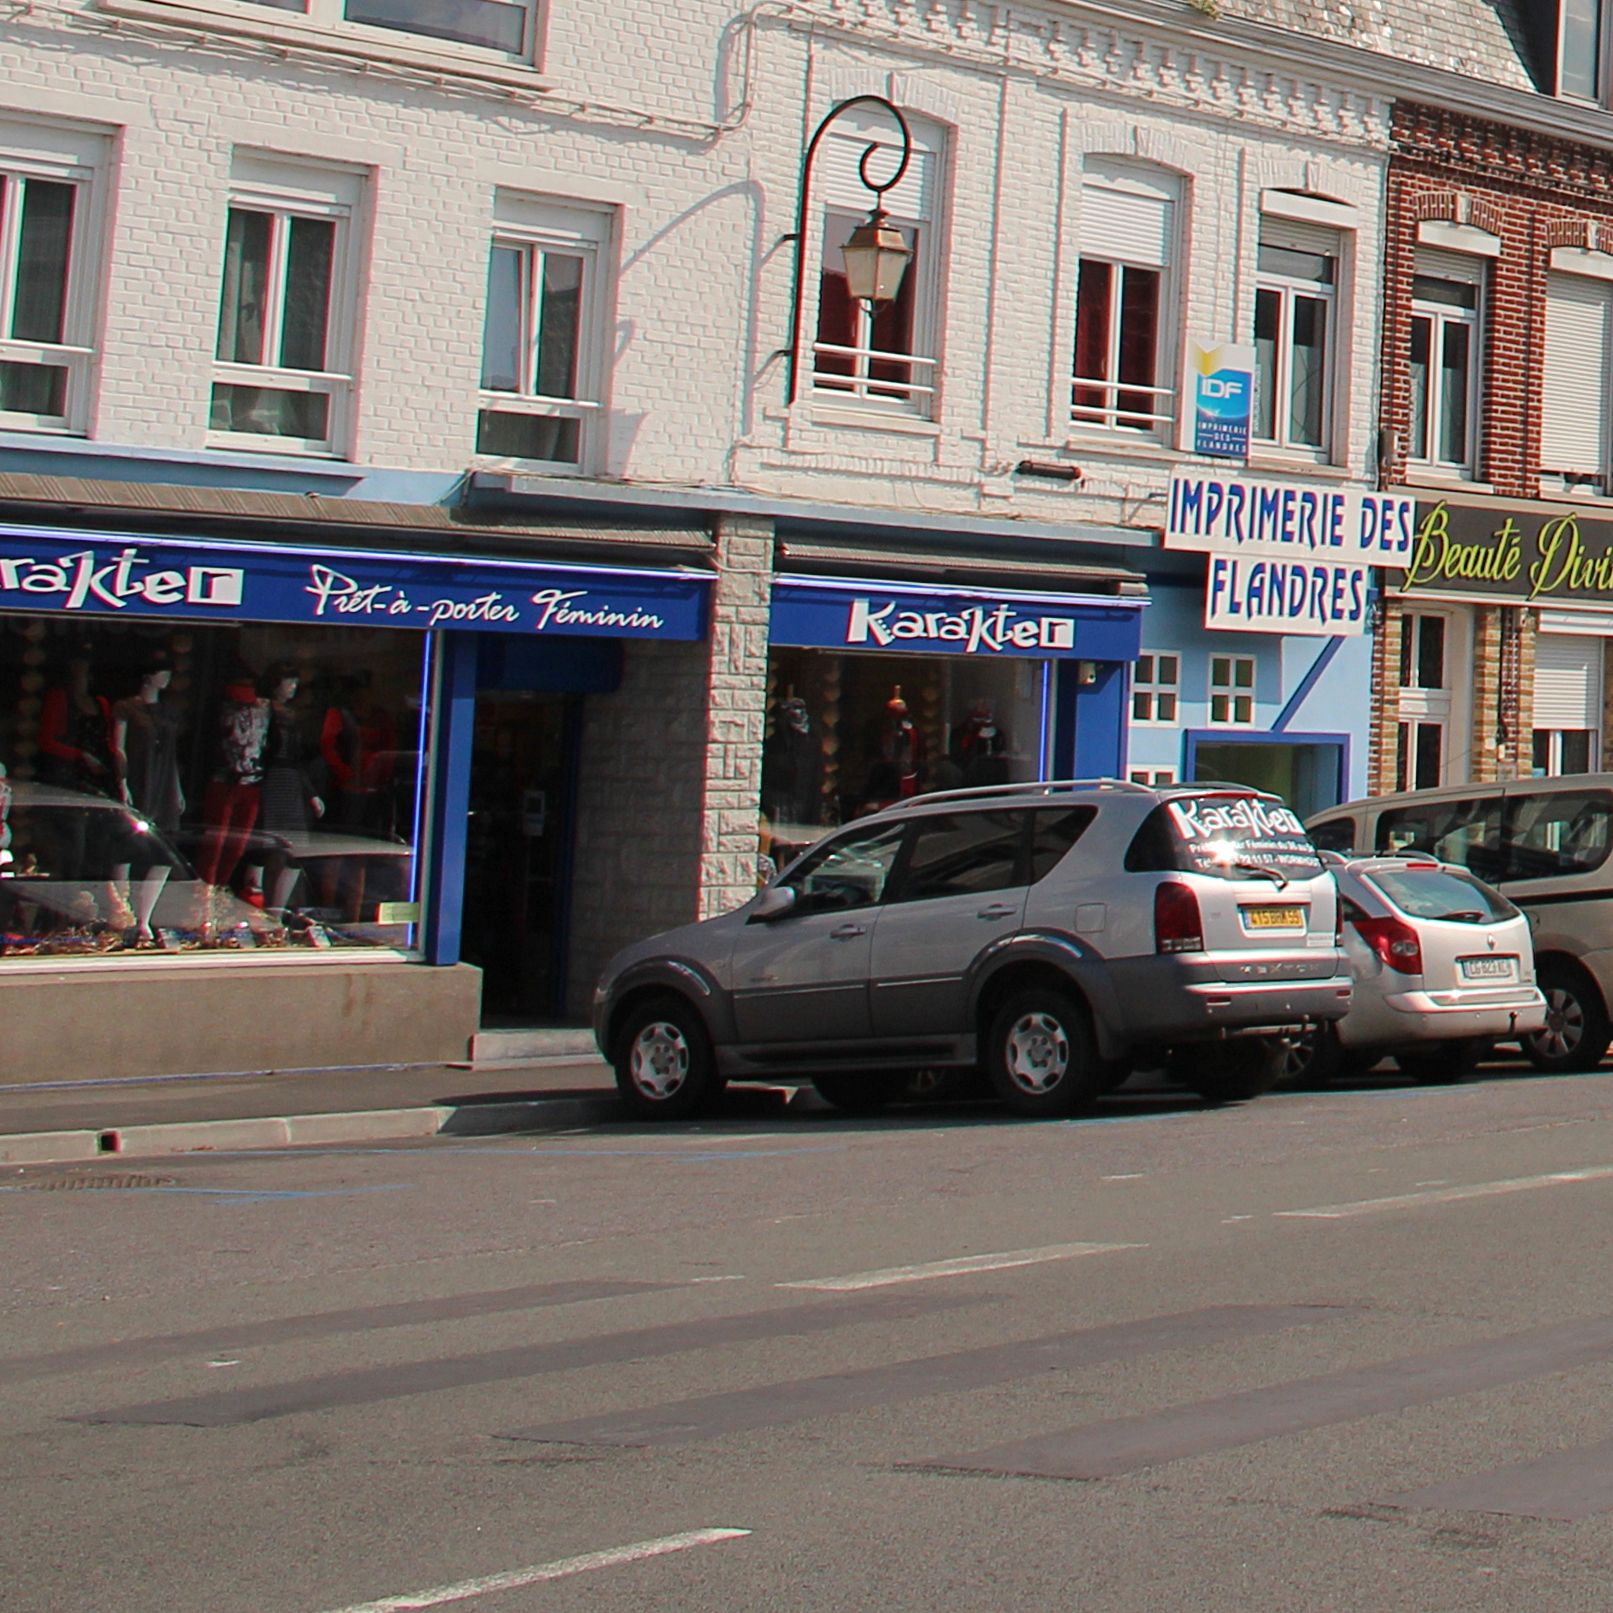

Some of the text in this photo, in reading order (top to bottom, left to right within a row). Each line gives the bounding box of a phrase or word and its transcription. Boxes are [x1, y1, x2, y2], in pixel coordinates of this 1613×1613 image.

[1201, 378, 1243, 399] IDF
[1197, 440, 1247, 453] FLANDRES
[1198, 422, 1247, 435] IMPRIMERIE
[1214, 433, 1231, 442] DES
[1169, 477, 1412, 554] IMPRIMERIE DES
[1403, 500, 1523, 592] Beauté
[531, 589, 664, 630] Féminin
[1210, 557, 1366, 623] FLANDRES
[846, 597, 1075, 654] Karakter
[1167, 798, 1306, 839] Karakter
